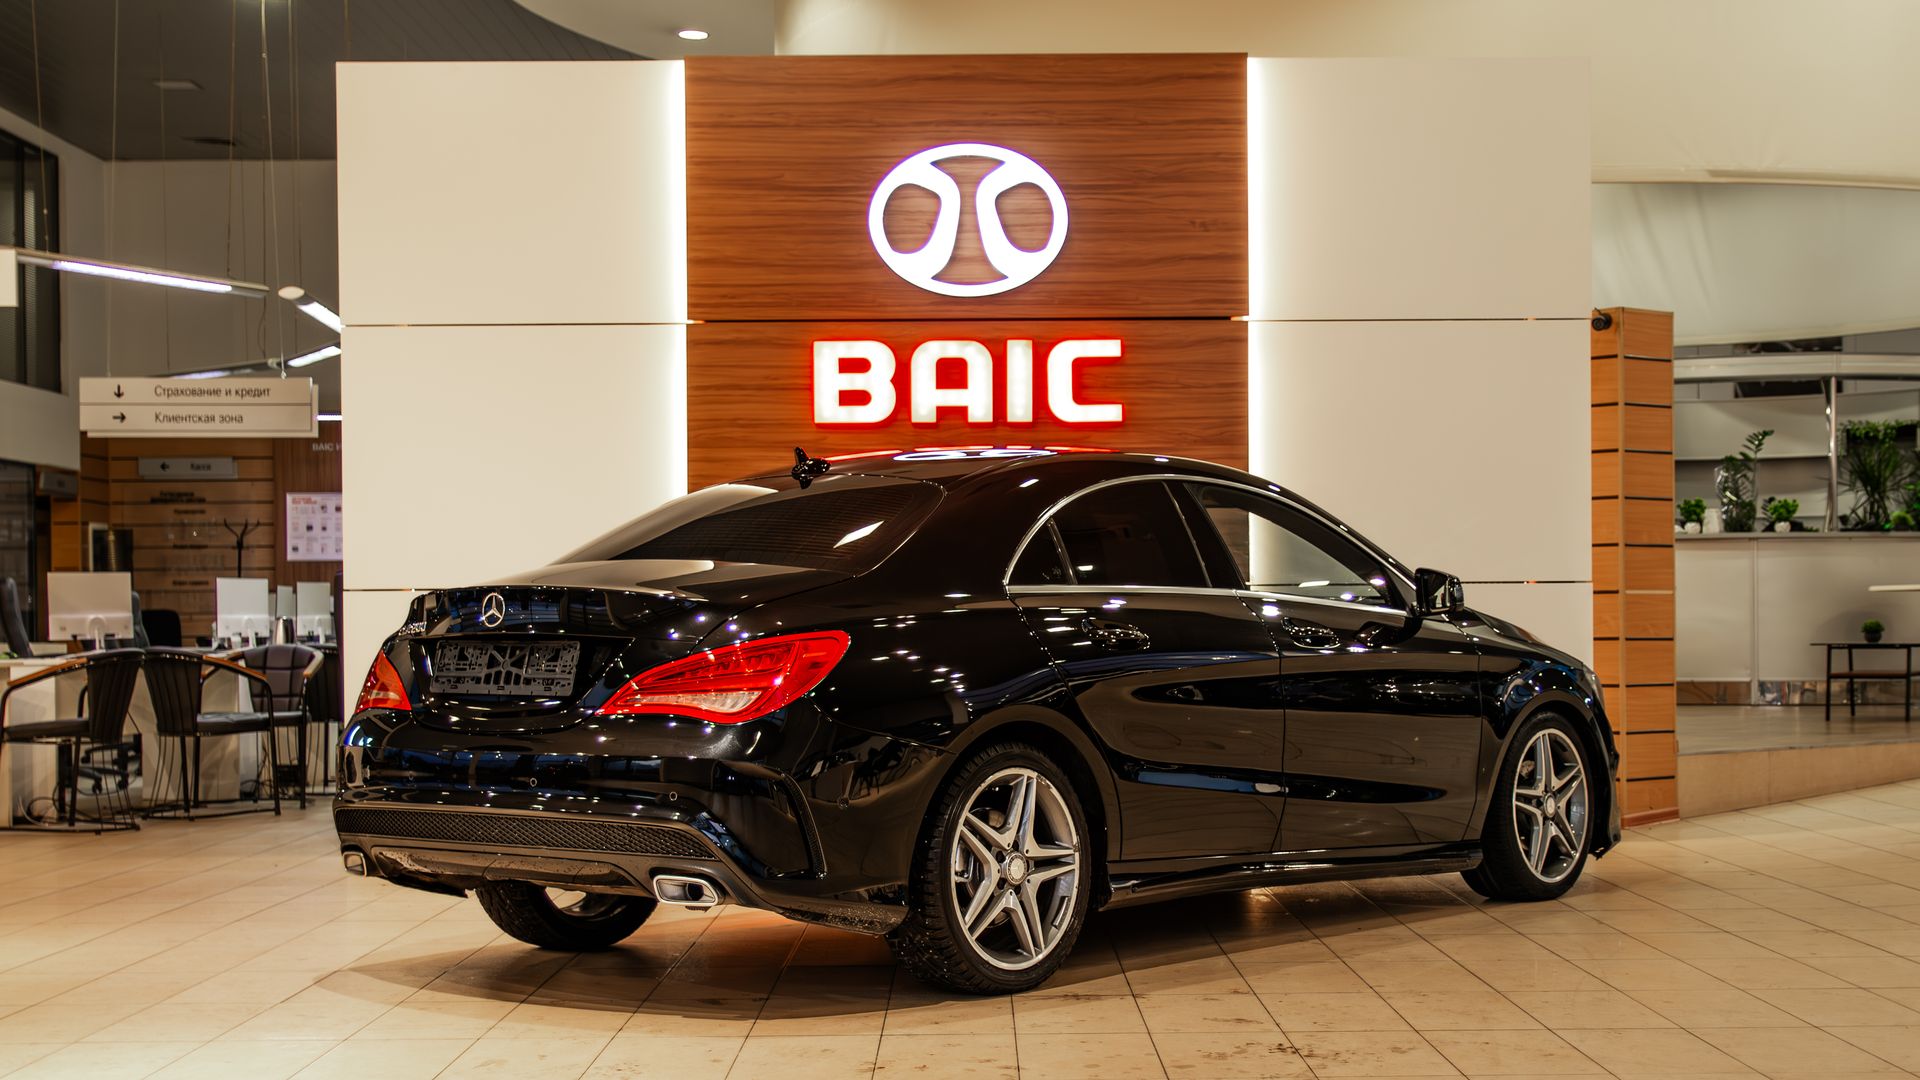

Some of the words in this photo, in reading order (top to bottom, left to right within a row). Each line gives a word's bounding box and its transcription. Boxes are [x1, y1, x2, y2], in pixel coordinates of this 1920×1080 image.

[813, 339, 1123, 424] BAIC
[154, 385, 222, 398] Страхование
[225, 388, 232, 396] и
[235, 387, 271, 398] кредит
[154, 412, 216, 424] Клиентская
[219, 414, 244, 424] зона
